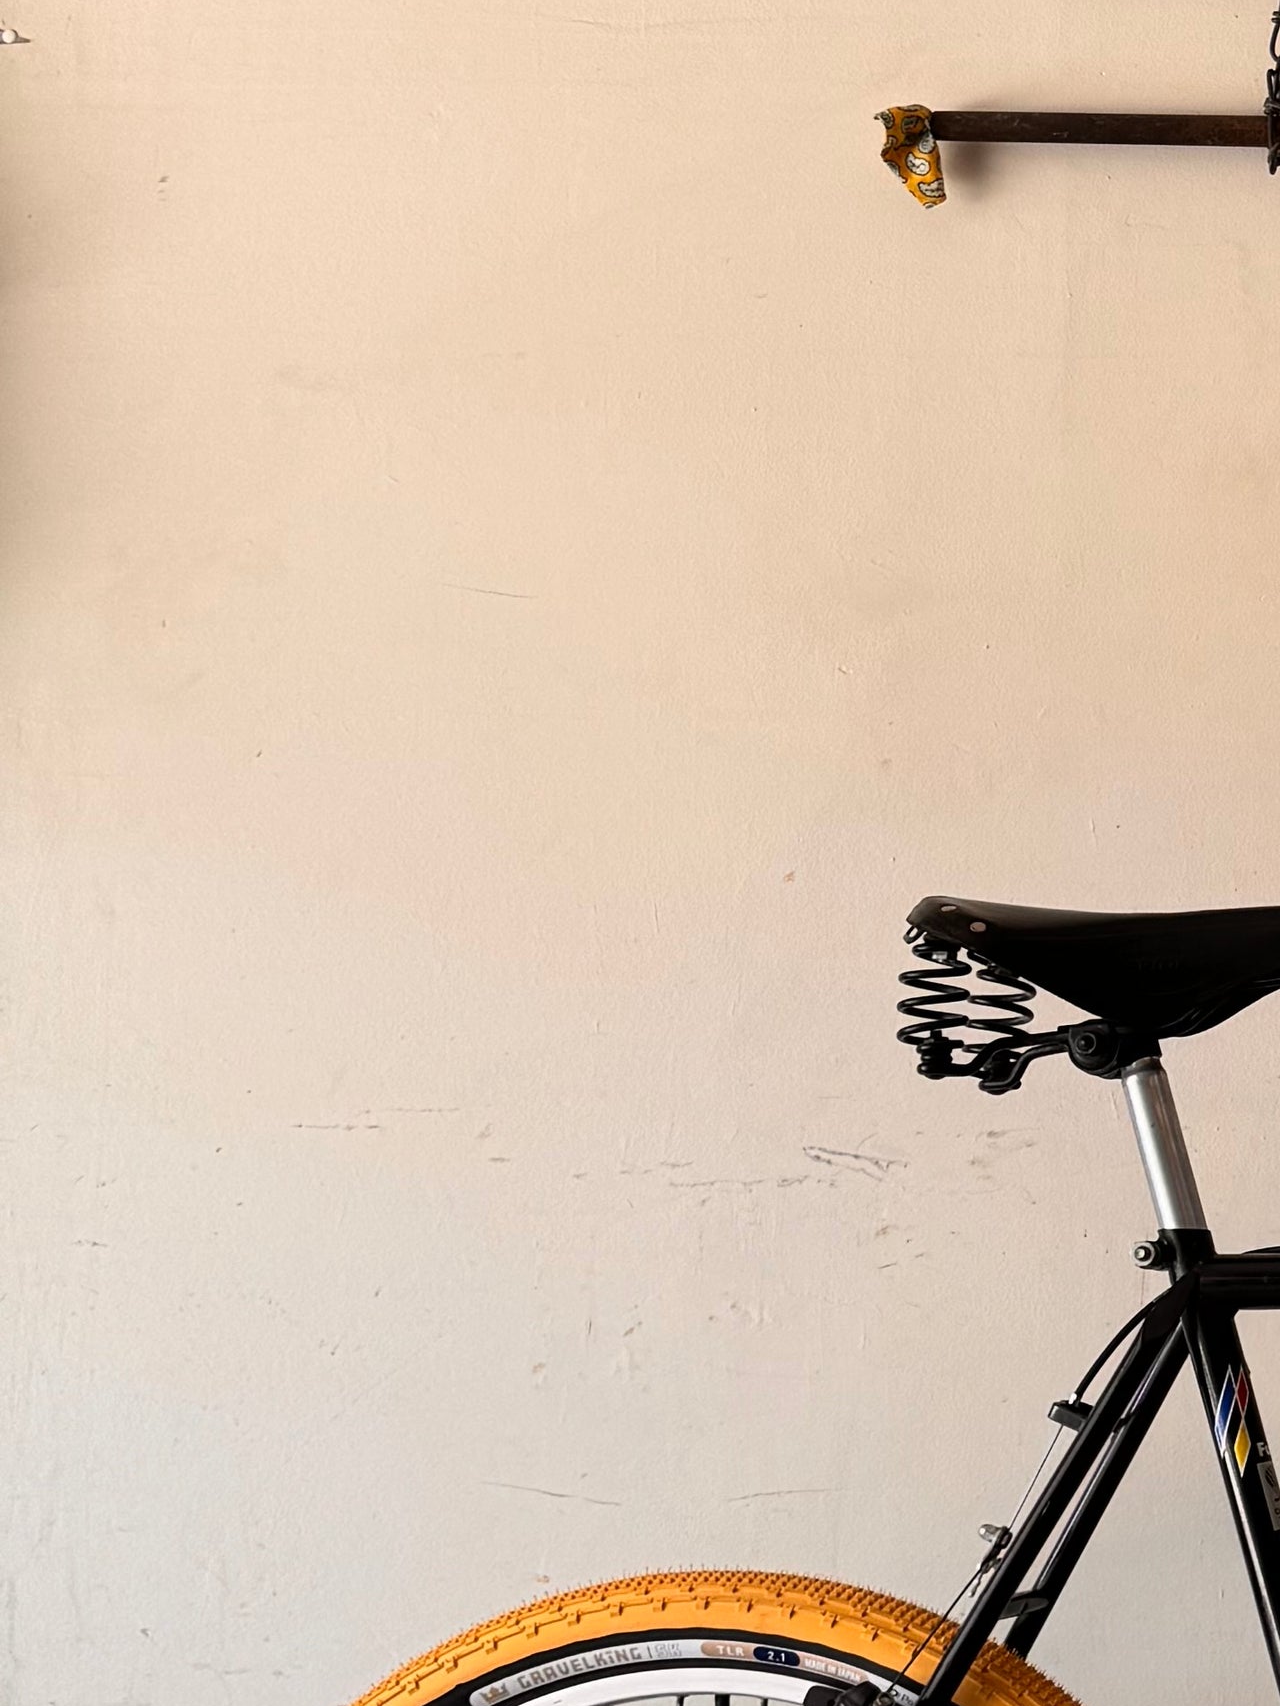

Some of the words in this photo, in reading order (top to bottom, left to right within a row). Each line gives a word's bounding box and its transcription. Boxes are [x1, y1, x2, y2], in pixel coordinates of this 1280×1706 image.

[715, 1644, 746, 1658] TLR
[767, 1649, 786, 1663] 2.1
[804, 1658, 825, 1672] MADE
[837, 1666, 862, 1682] JAPAN
